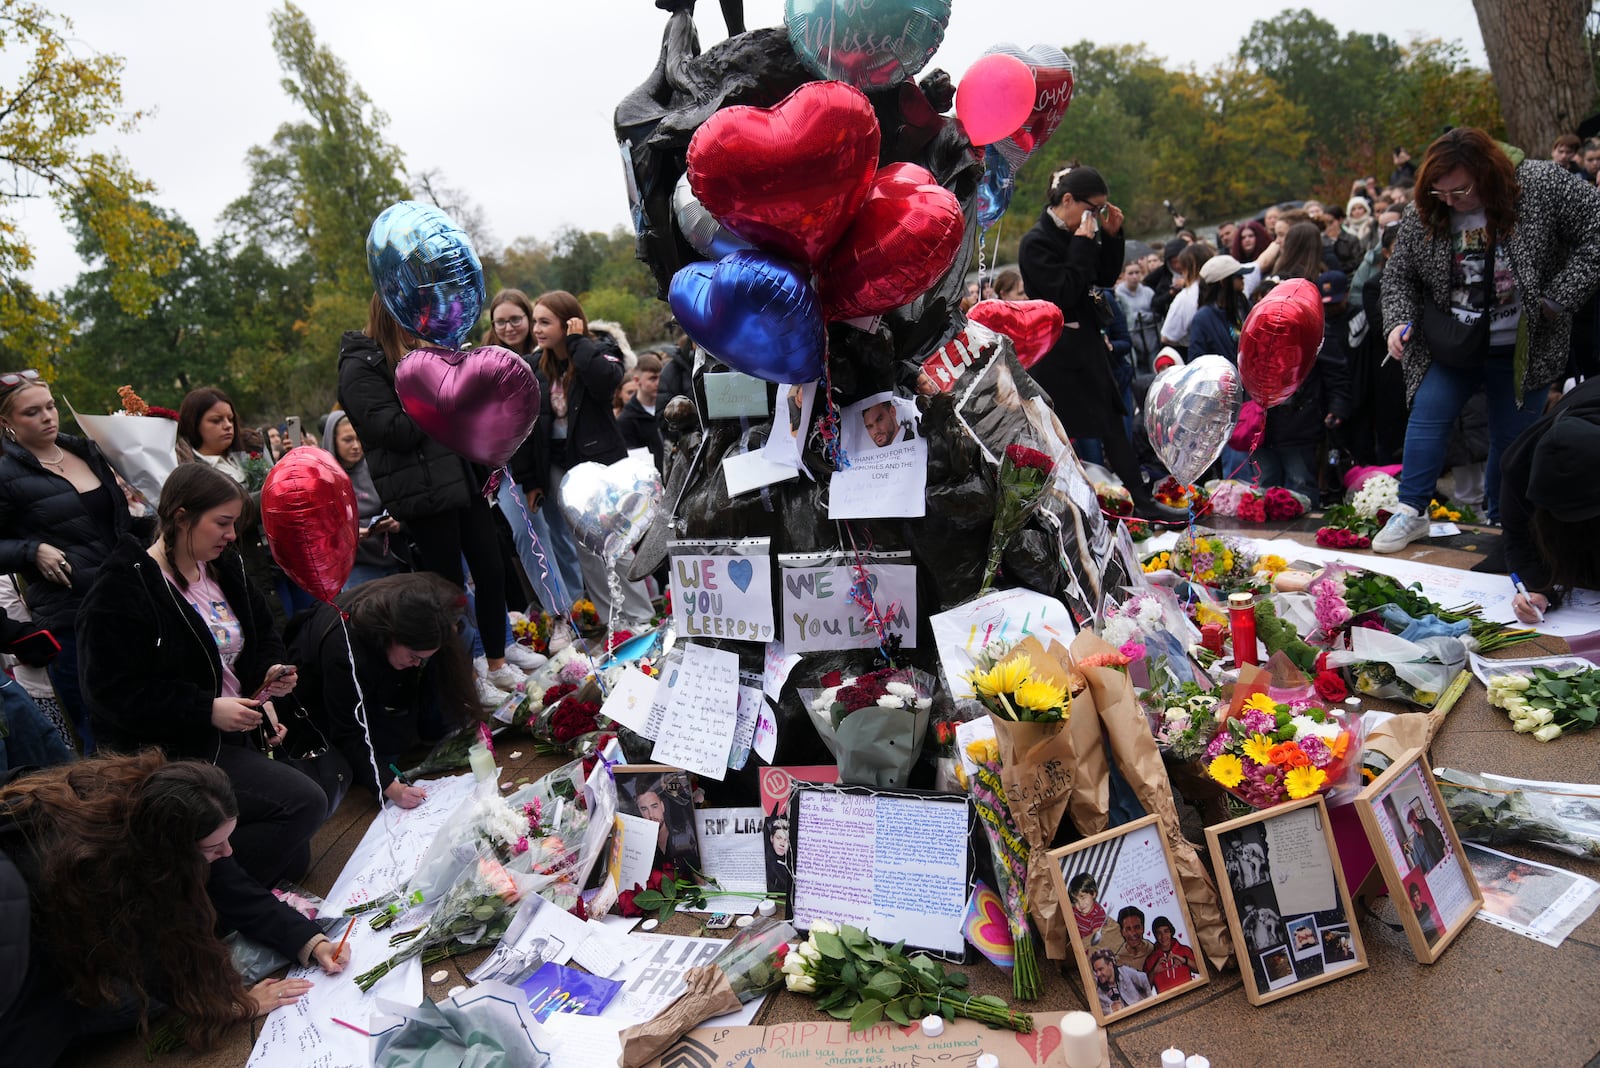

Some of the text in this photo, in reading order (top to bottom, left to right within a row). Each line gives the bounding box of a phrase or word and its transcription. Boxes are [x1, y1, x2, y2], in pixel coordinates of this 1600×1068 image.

[804, 16, 911, 56] Missed
[854, 456, 875, 464] THANK
[876, 452, 889, 460] YOU
[890, 449, 903, 457] FOR
[904, 446, 916, 454] THE
[677, 560, 718, 590] WE
[786, 572, 835, 599] WE
[683, 591, 722, 616] YOU
[687, 616, 759, 640] LEEROY
[768, 773, 785, 794] 1D
[705, 818, 729, 835] RIP
[1120, 888, 1135, 899] RIGHT
[1155, 878, 1169, 889] WERE
[1139, 886, 1169, 904] HERE WITH
[650, 939, 724, 968] LIA
[712, 1029, 730, 1042] LP
[770, 1022, 892, 1048] RIP Liam
[781, 1038, 979, 1060] Thank you for the best childhood
